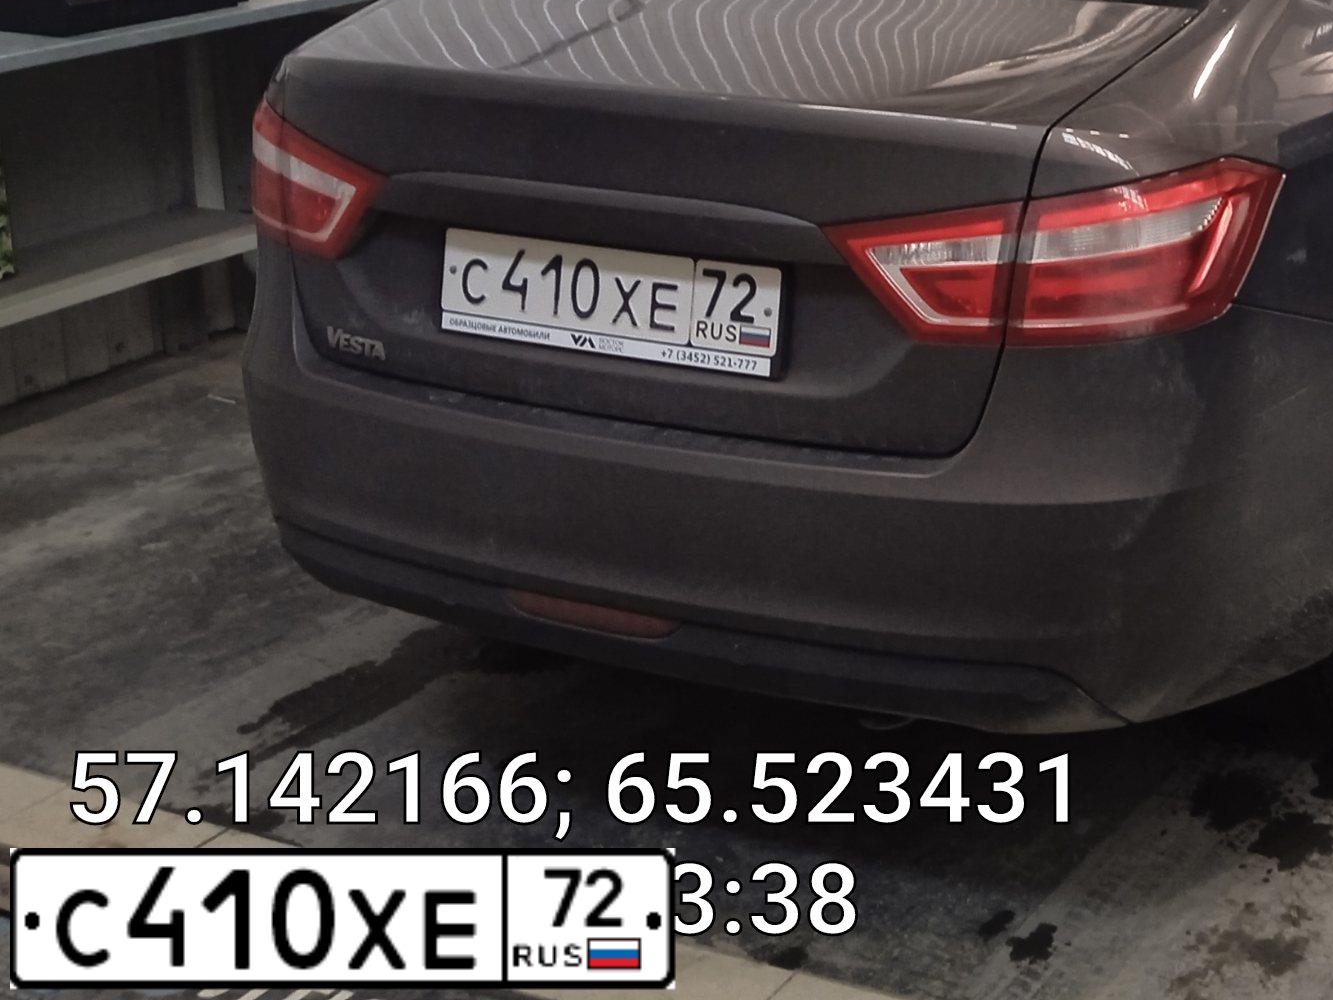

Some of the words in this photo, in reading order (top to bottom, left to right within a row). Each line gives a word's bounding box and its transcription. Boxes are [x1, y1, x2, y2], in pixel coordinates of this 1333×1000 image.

[702, 267, 759, 324] 72
[326, 326, 386, 360] VESTA
[695, 321, 737, 343] RUS
[661, 349, 673, 359] +7
[676, 351, 711, 365] (3452)
[713, 355, 757, 371] 521-777
